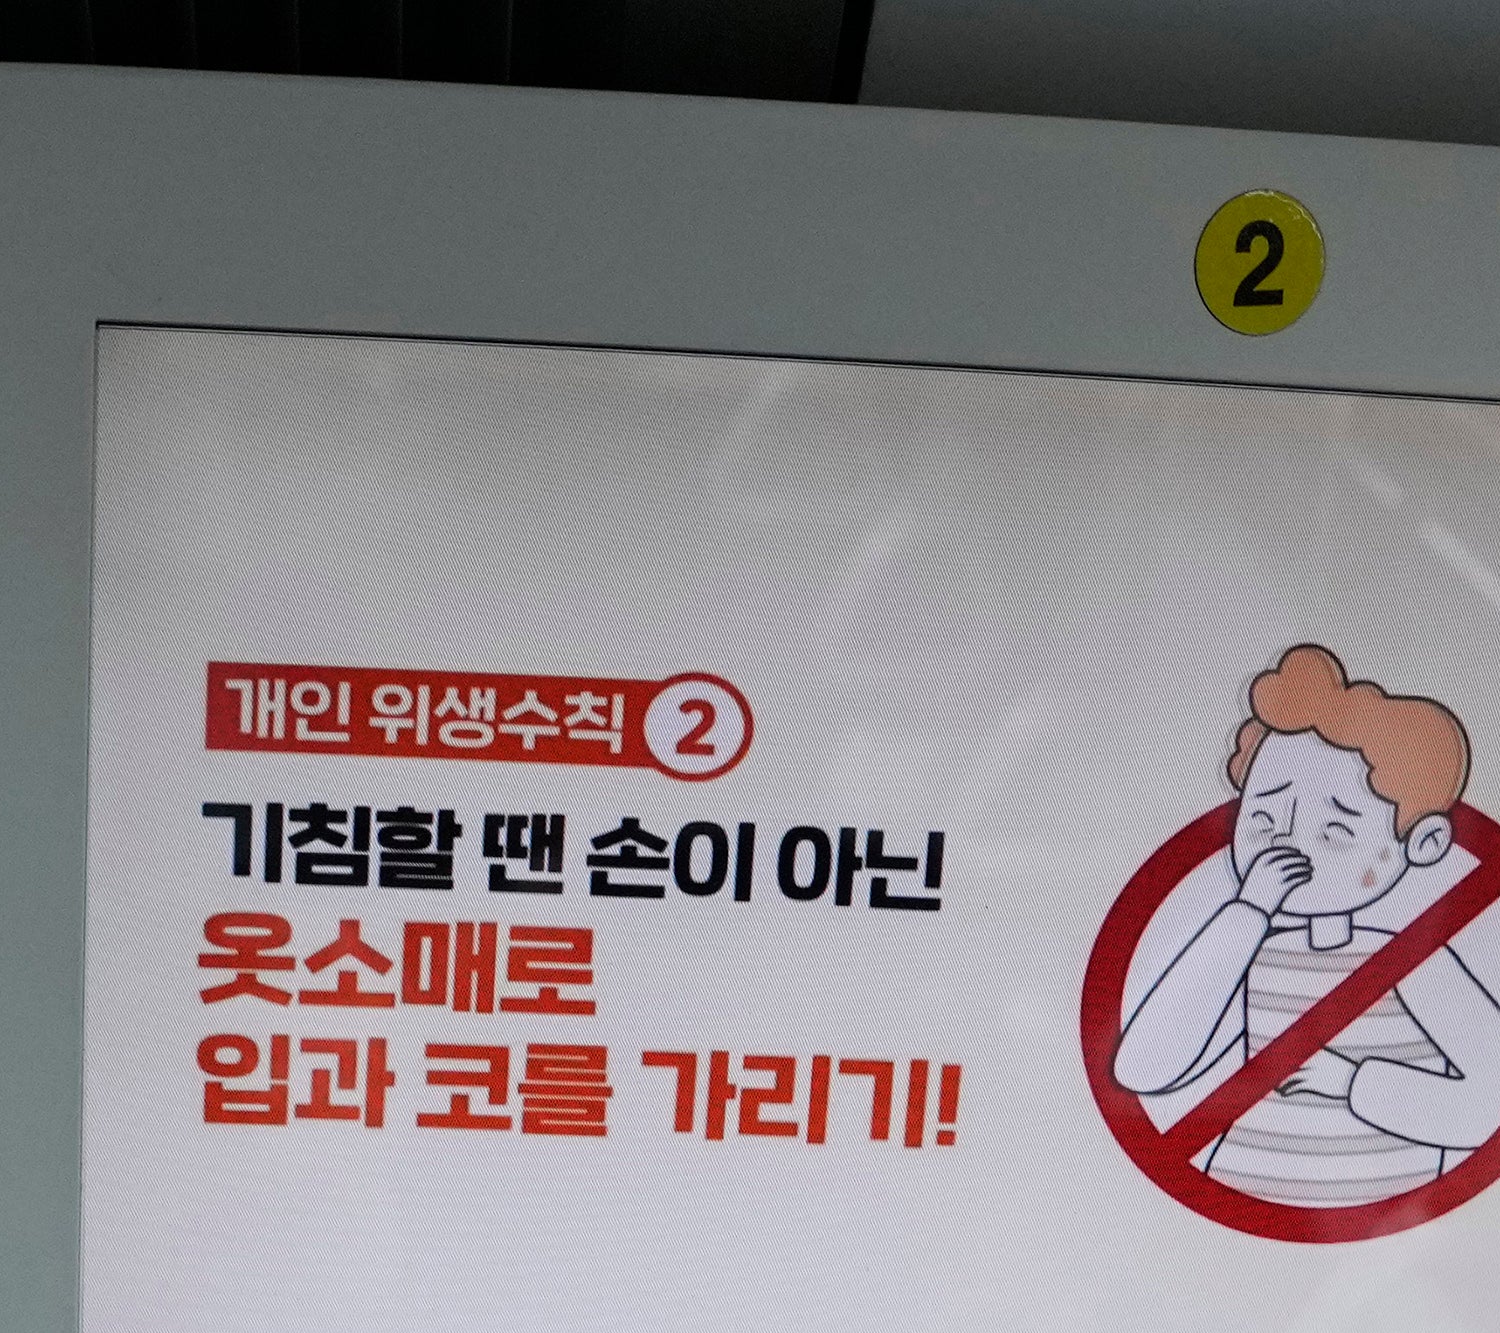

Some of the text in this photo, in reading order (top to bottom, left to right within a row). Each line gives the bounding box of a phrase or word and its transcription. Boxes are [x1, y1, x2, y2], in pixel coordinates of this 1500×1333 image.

[1233, 220, 1285, 307] 2
[223, 676, 351, 744] 개인
[367, 682, 626, 753] 위생수칙
[202, 801, 946, 912] 기침할 땐 손이 아닌
[198, 909, 597, 1016] 옷소매로
[198, 1032, 964, 1149] 입과 코를 가리기!
